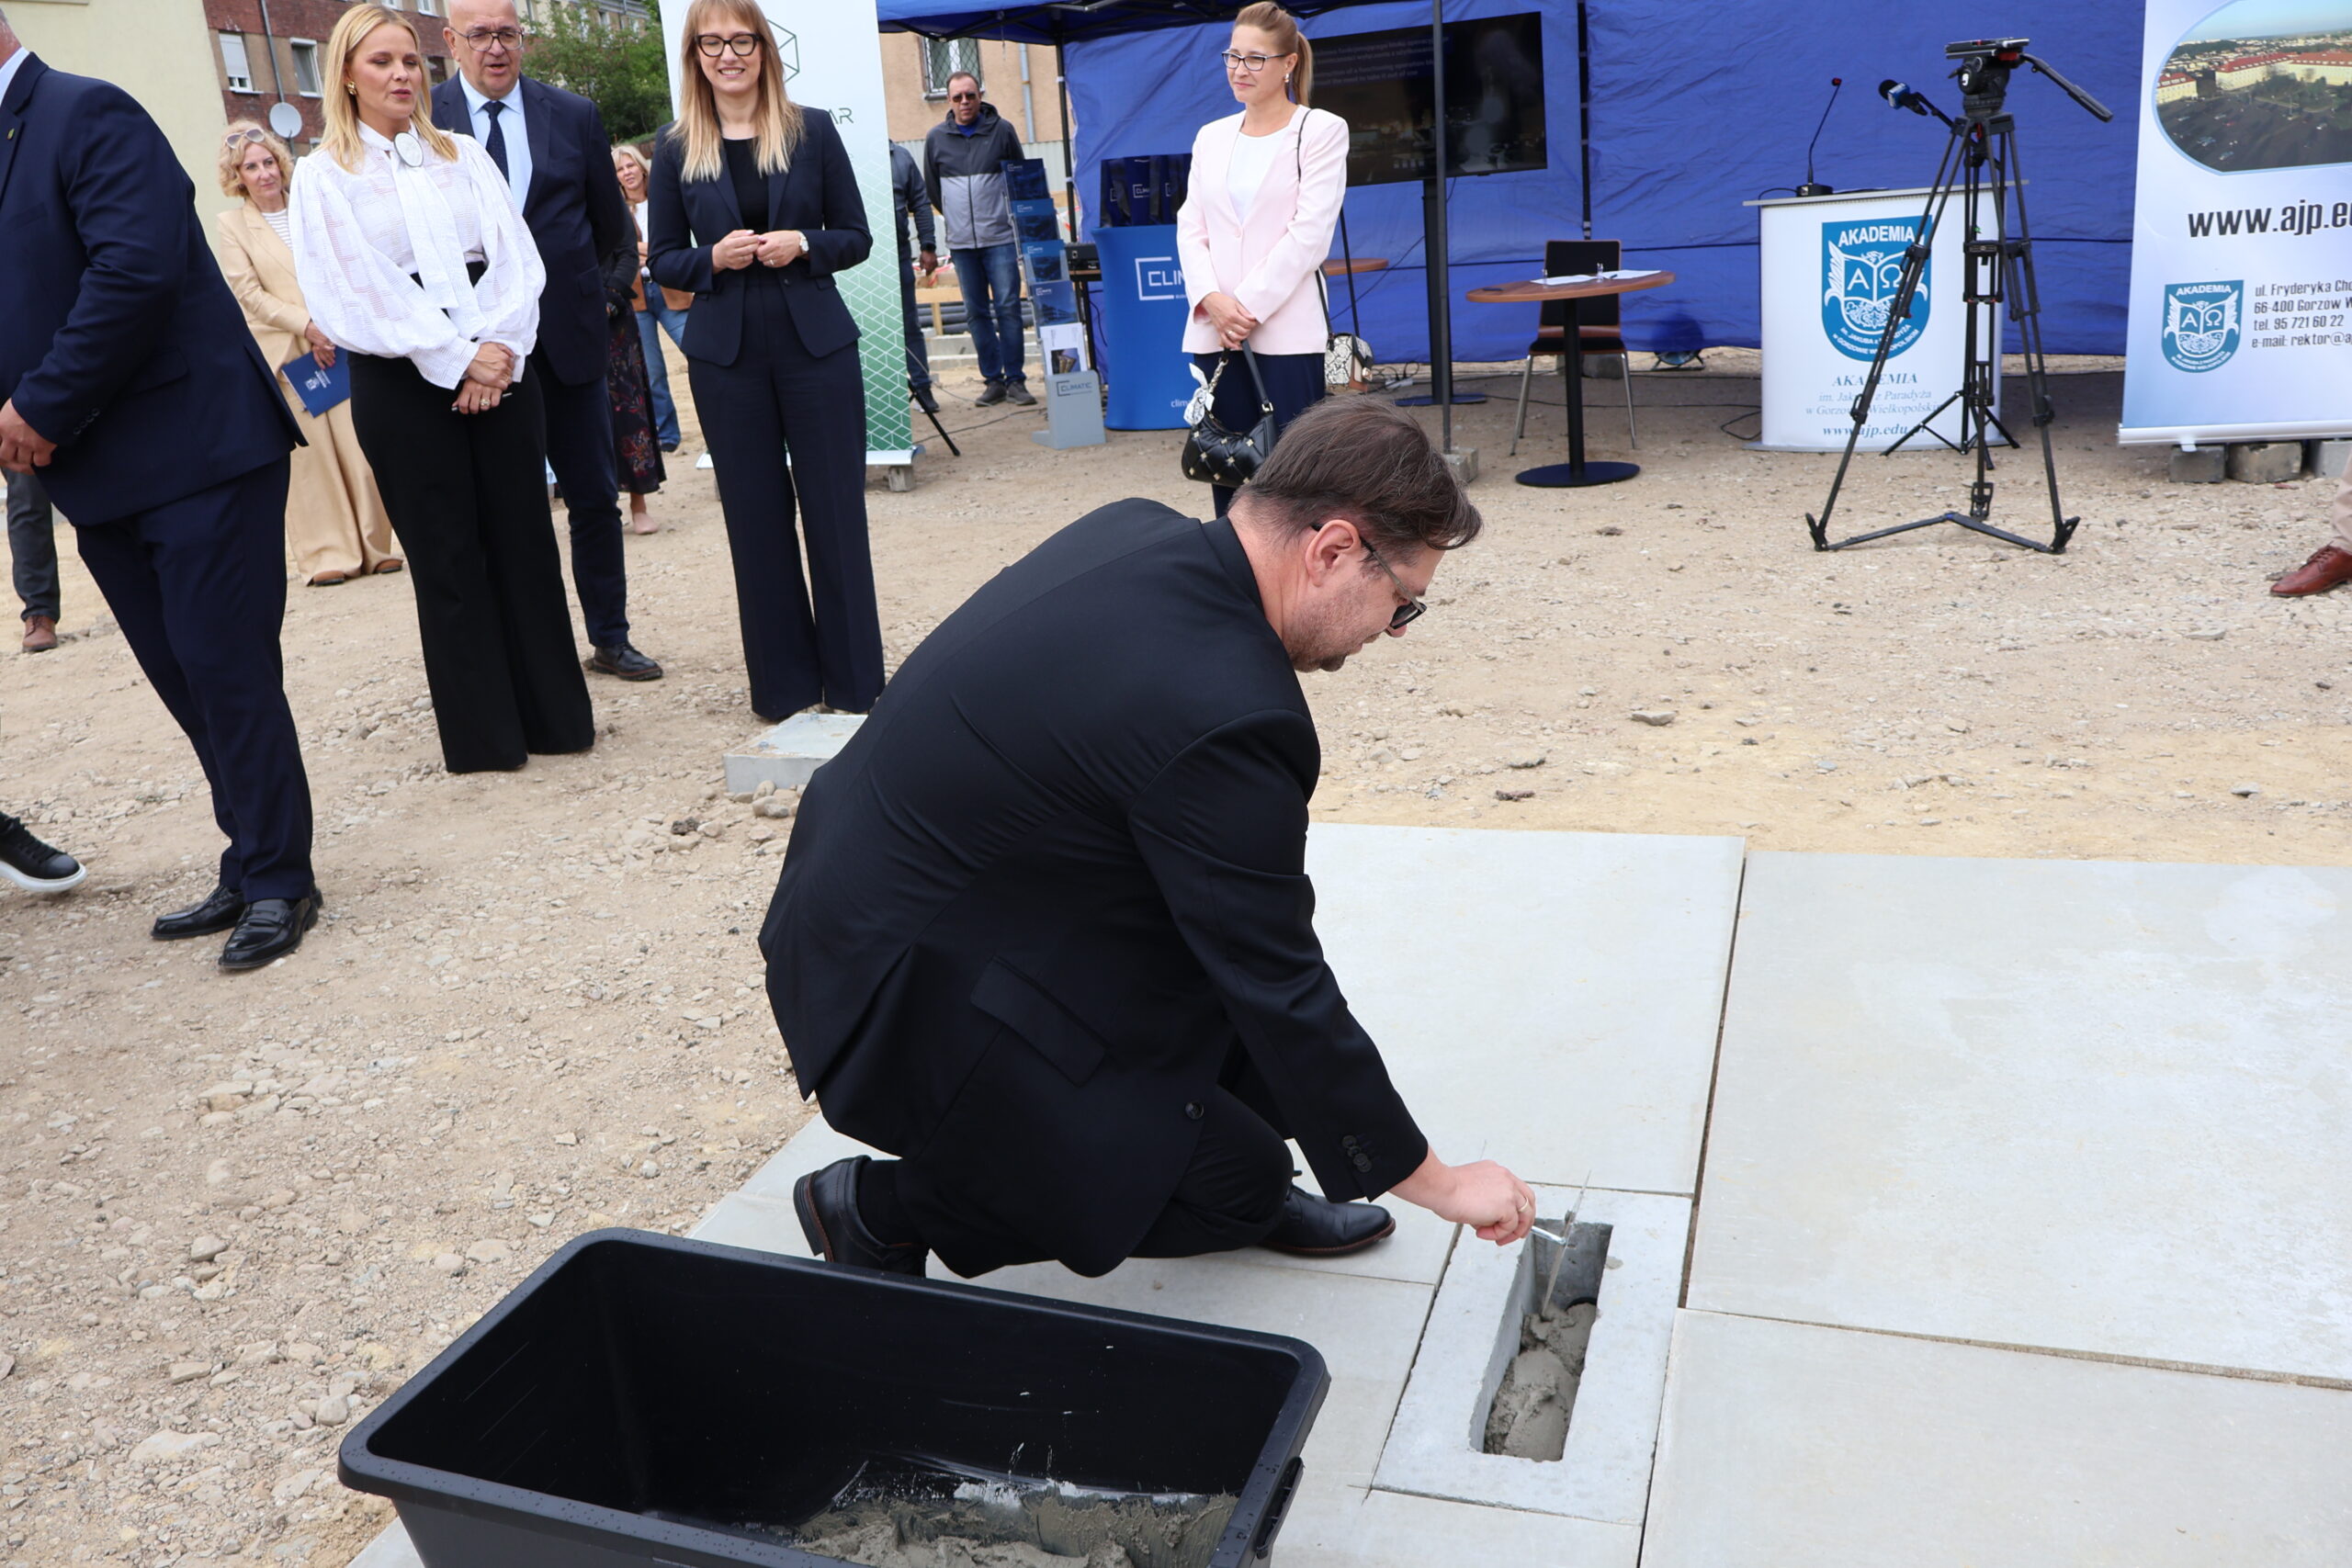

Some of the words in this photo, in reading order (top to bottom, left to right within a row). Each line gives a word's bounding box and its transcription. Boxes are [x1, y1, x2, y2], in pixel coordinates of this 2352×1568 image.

[2188, 199, 2352, 238] www.ajp.e
[1838, 225, 1916, 248] AKADEMIA
[2176, 285, 2233, 297] AKADEMIA
[2270, 281, 2332, 298] Fryderyka
[2254, 300, 2295, 314] 66-400
[2274, 318, 2288, 331] 95
[2291, 316, 2310, 329] 721
[2312, 315, 2327, 328] 60
[2330, 314, 2345, 327] 22
[1831, 372, 1918, 387] AKAEMIA
